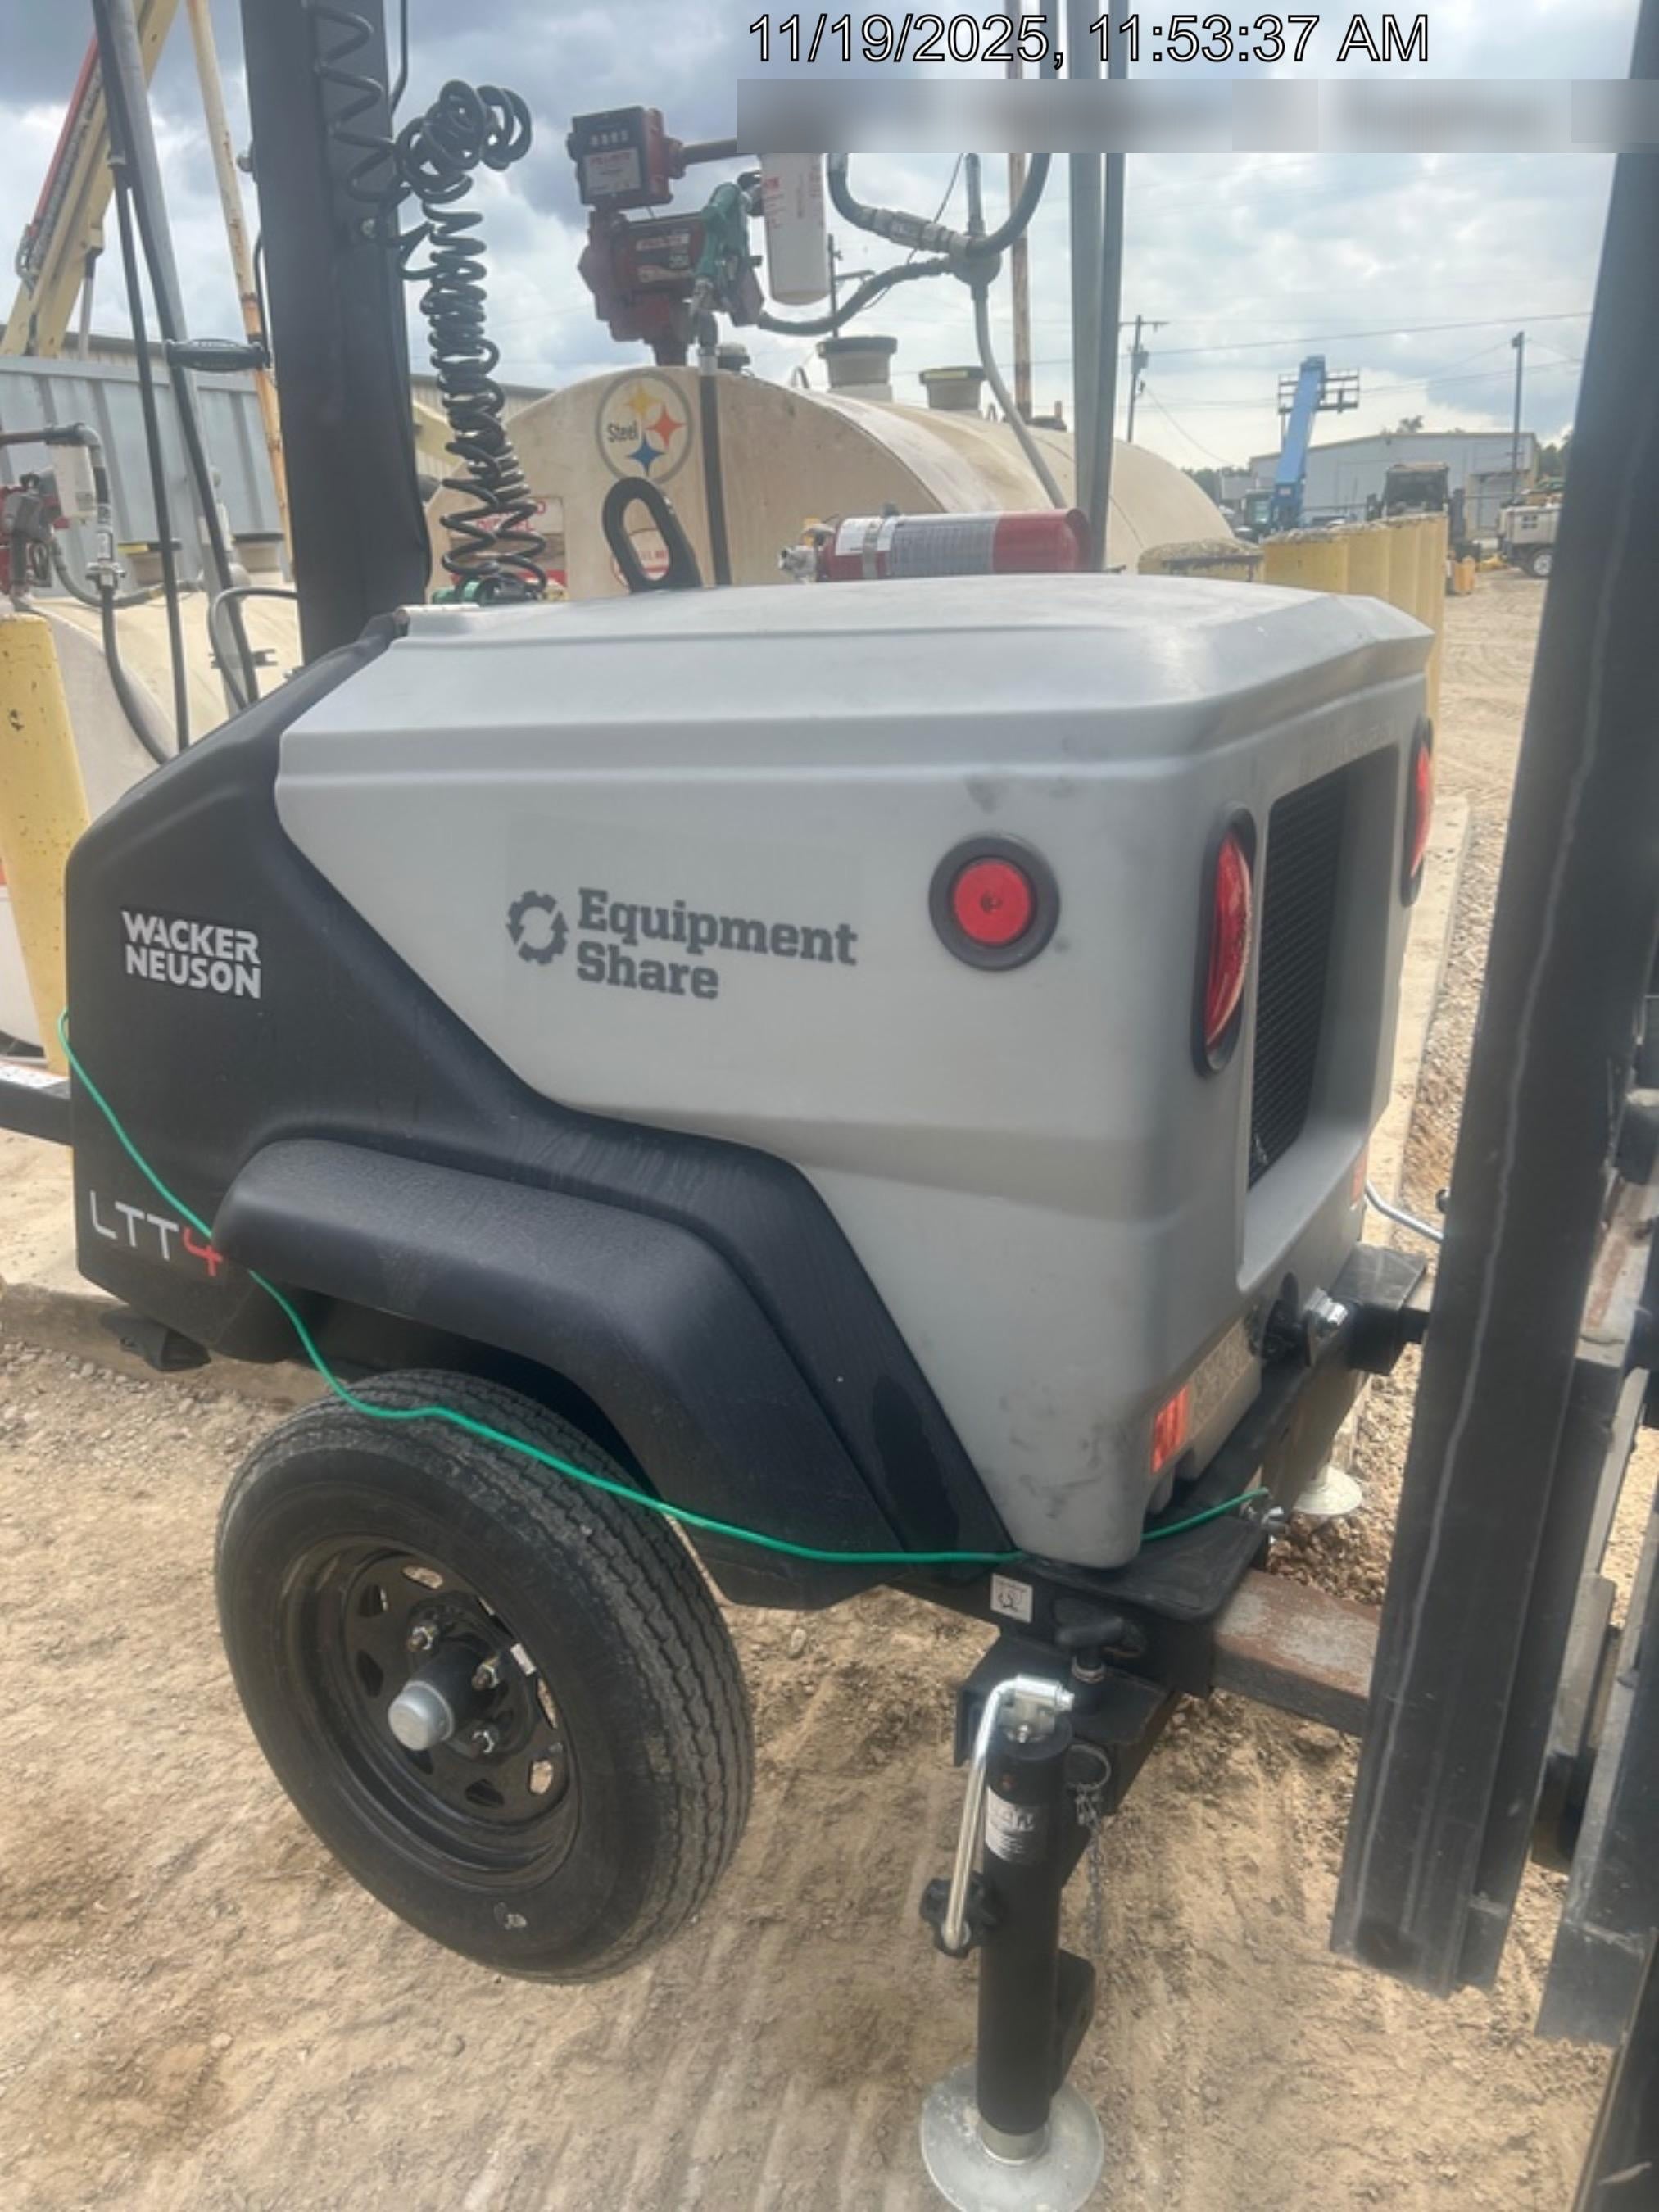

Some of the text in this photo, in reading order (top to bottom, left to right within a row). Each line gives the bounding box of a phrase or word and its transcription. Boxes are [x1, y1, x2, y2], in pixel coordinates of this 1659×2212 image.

[607, 419, 638, 442] Steel
[121, 910, 261, 965] WACKER
[578, 887, 858, 966] Equipment
[126, 943, 261, 999] NEUSON
[577, 940, 719, 1000] Share
[89, 1190, 223, 1276] LTT4
